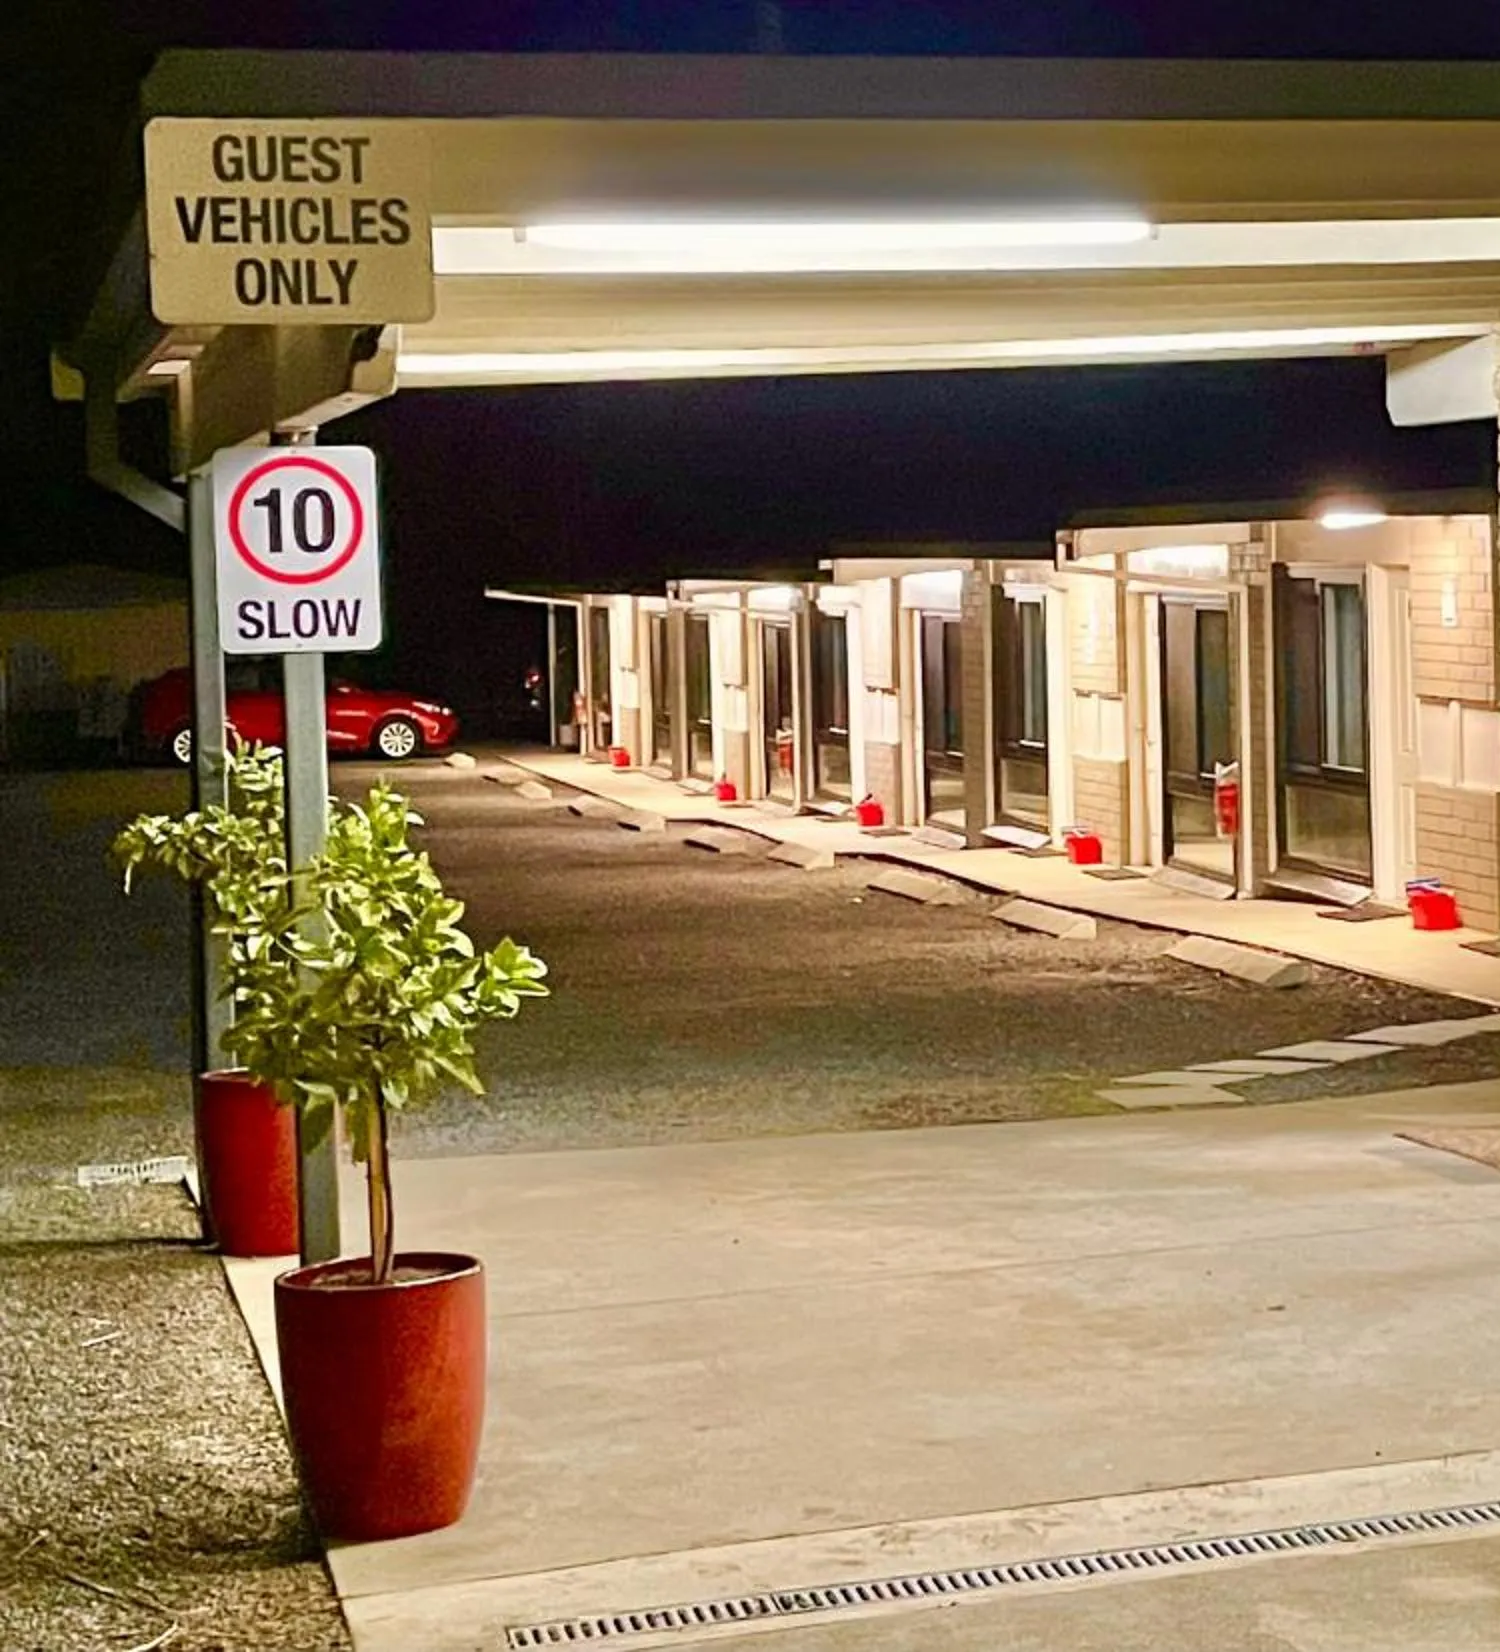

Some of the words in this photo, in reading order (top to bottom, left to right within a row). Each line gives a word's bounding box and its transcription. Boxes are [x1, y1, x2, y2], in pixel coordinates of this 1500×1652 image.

[212, 135, 370, 183] GUEST
[175, 197, 410, 245] VEHICLES
[235, 258, 358, 306] ONLY
[253, 487, 336, 554] 10
[238, 599, 362, 640] SLOW
